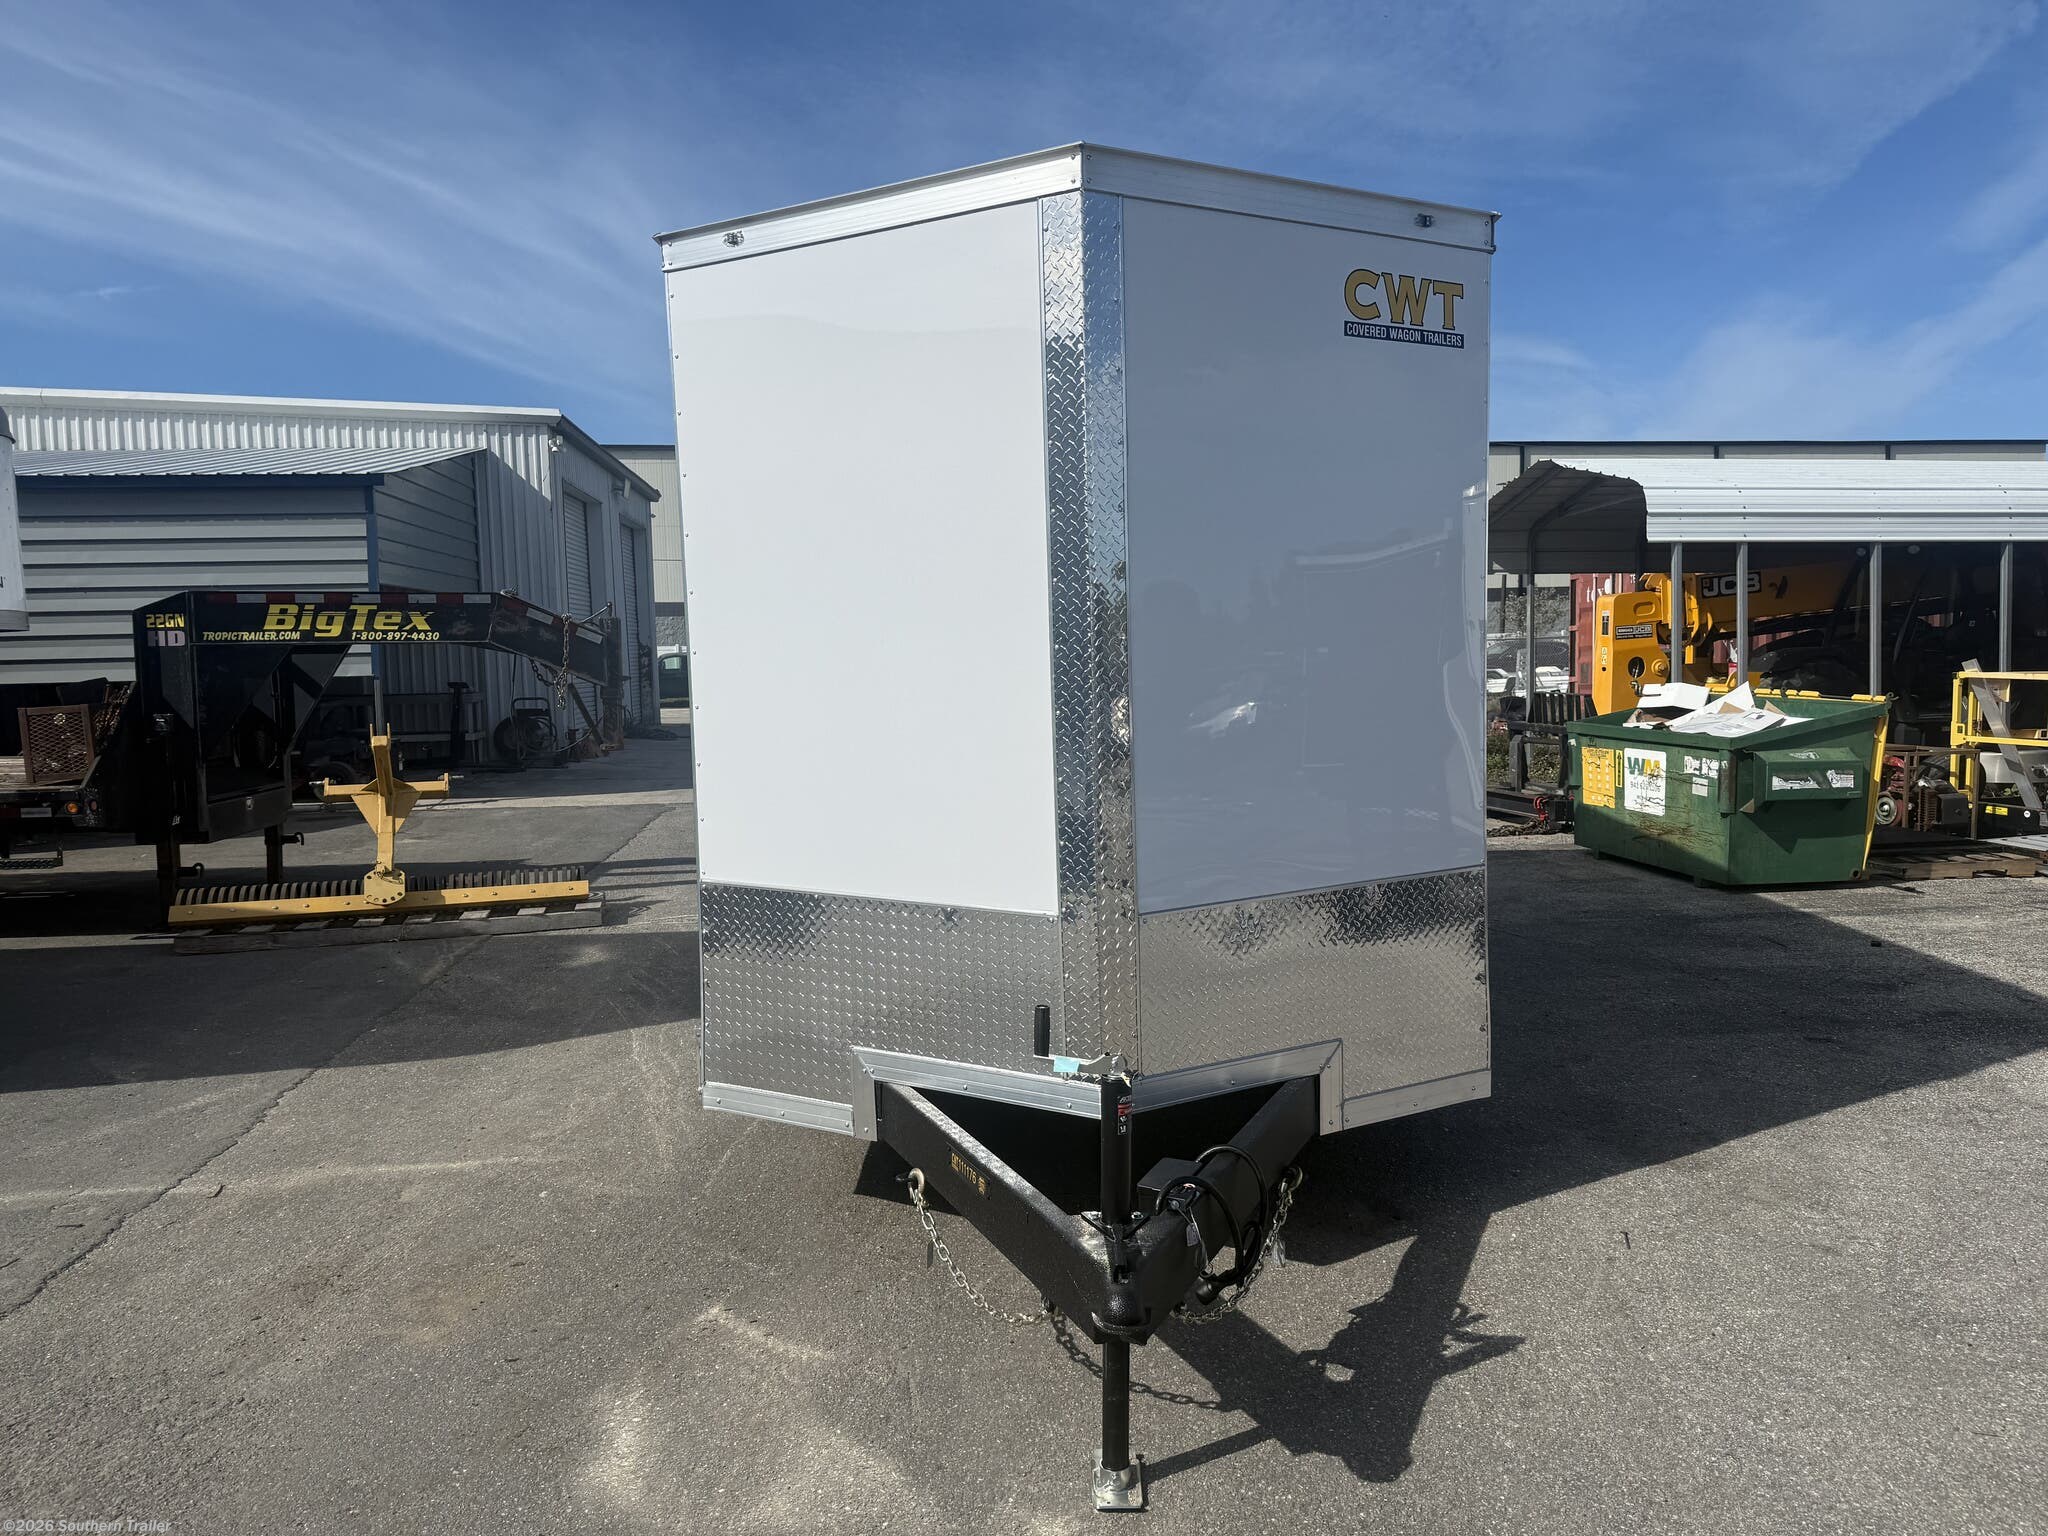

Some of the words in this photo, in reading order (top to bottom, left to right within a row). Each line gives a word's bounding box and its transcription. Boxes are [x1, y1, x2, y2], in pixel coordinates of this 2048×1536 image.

[1344, 268, 1464, 331] CWT
[1346, 323, 1387, 338] COVERED
[1389, 328, 1421, 342] WAGON
[1423, 331, 1462, 347] TRAILERS
[1702, 573, 1761, 597] JCB
[145, 613, 185, 628] 22GN
[147, 630, 186, 647] HD
[202, 631, 301, 641] TROPICTRAILER.COM
[351, 631, 440, 641] 1-800-897-4430
[1627, 756, 1661, 777] WM
